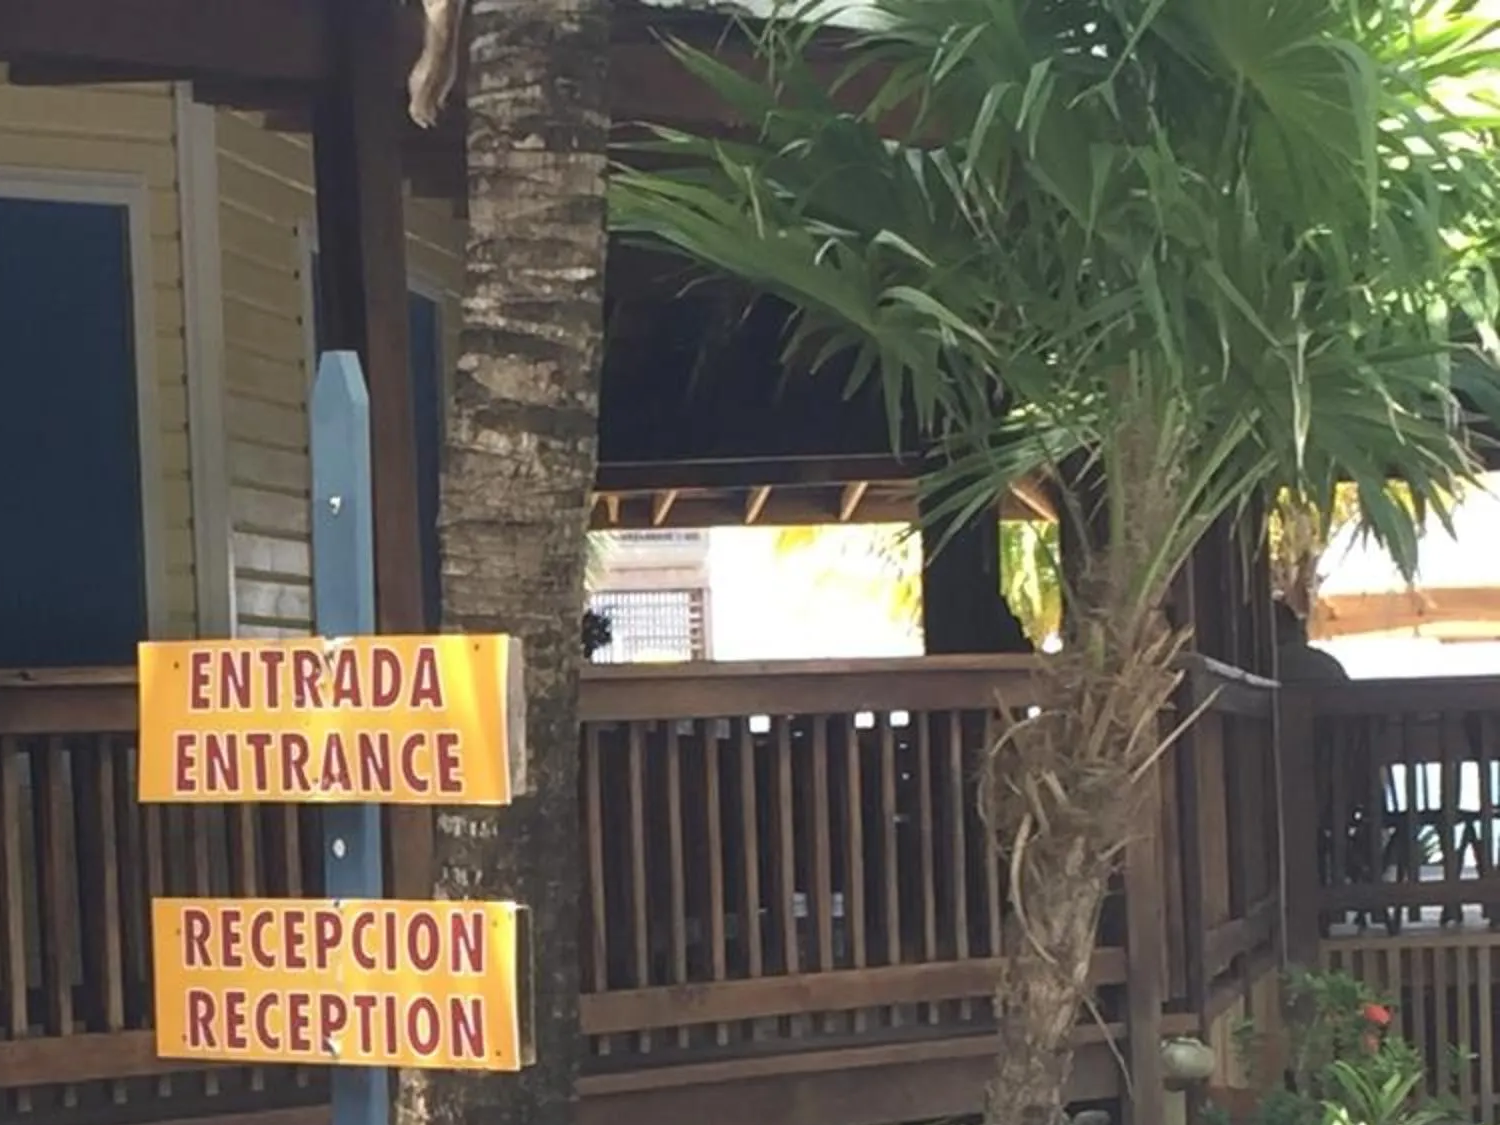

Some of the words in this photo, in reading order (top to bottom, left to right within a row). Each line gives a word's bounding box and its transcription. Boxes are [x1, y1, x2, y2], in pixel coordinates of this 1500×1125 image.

[191, 648, 443, 709] ENTRADA
[175, 733, 463, 792] ENTRANCE
[184, 910, 484, 972] RECEPCION
[189, 991, 485, 1056] RECEPTION
